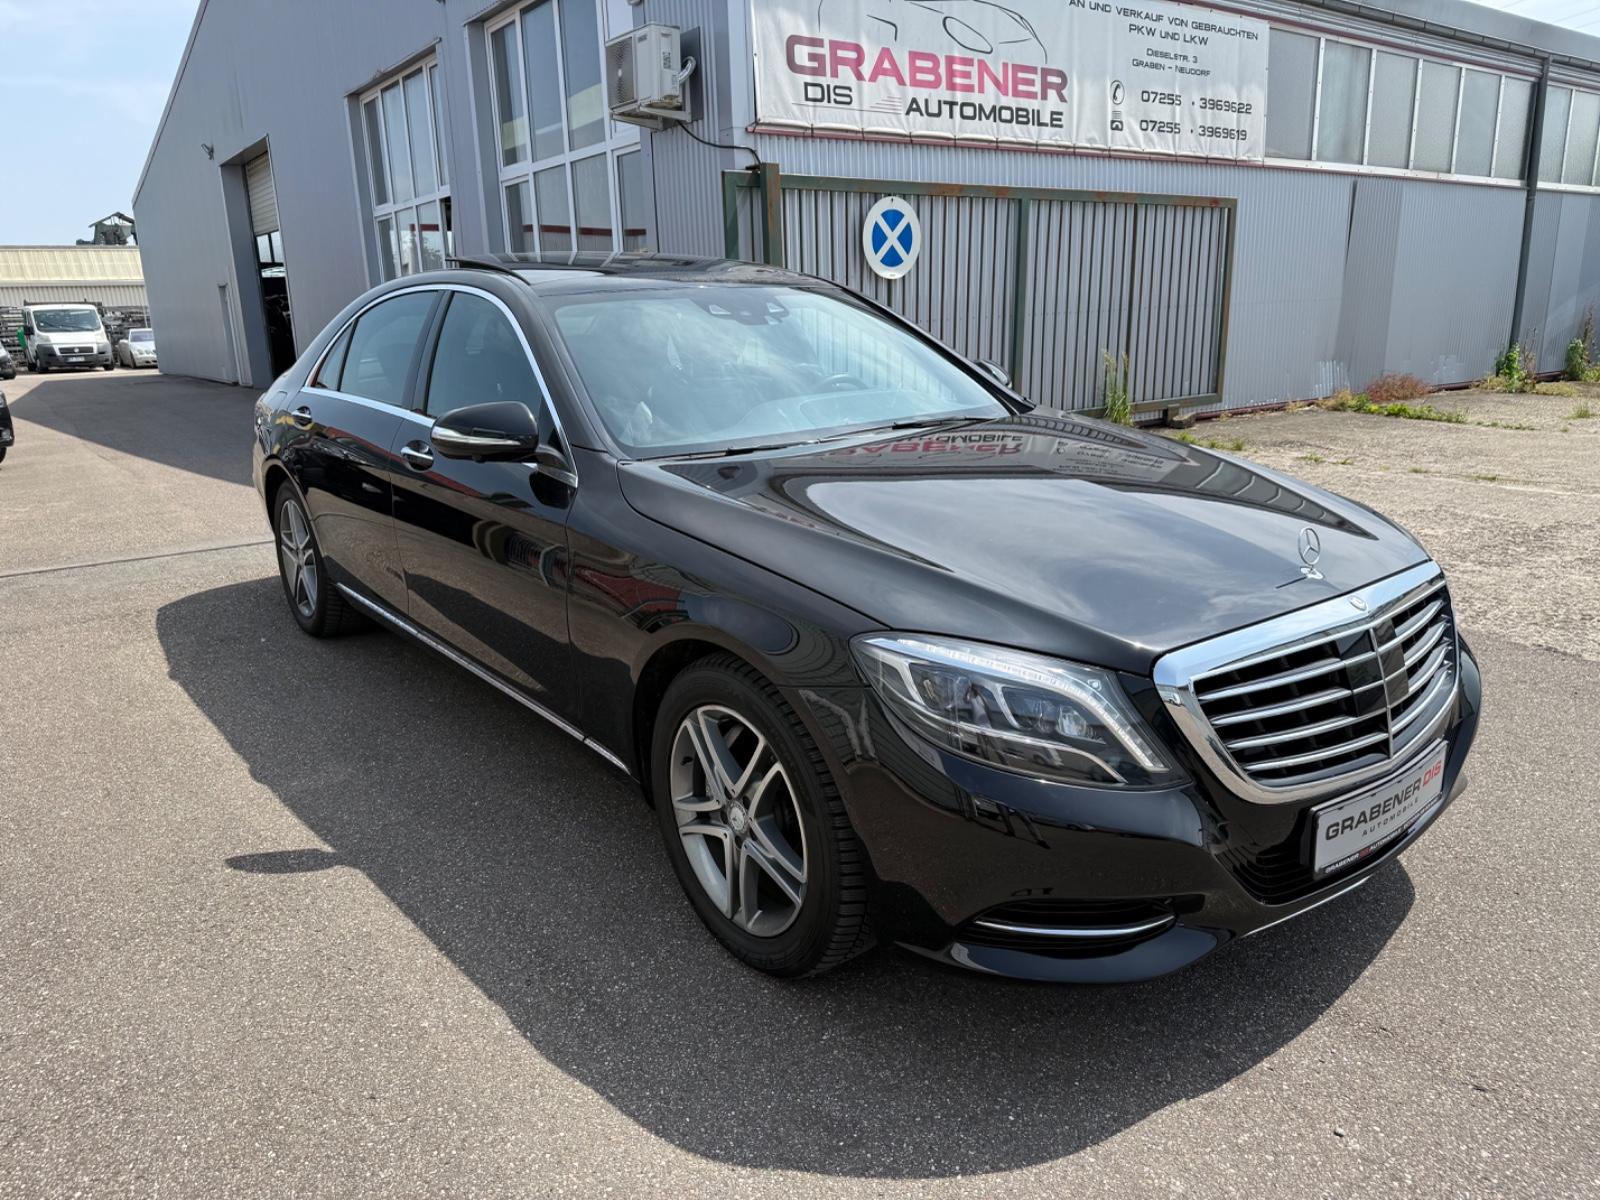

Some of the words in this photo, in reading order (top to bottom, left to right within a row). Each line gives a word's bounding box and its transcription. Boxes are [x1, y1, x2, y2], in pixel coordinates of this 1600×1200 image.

[1068, 0, 1085, 9] AN
[1089, 1, 1112, 13] UND
[1115, 5, 1164, 23] VERKAUF
[1167, 16, 1188, 28] VON
[1191, 21, 1259, 41] GEBRAUCHTEN
[1128, 23, 1156, 37] PKW
[1159, 31, 1180, 42] UND
[1183, 35, 1209, 46] LKW
[785, 34, 1068, 103] GRABENER
[1132, 58, 1165, 71] GRABEN
[1174, 65, 1211, 77] NEUDORF
[1192, 55, 1198, 64] 3
[803, 81, 853, 106] DIS
[905, 96, 1064, 129] AUTOMOBILE
[1141, 90, 1182, 106] 07255
[1199, 97, 1252, 115] 3969622
[1139, 119, 1181, 134] 07255
[1198, 125, 1247, 141] 3969619
[1325, 778, 1421, 841] GRABENER
[1422, 760, 1441, 787] DIS
[1362, 797, 1418, 837] AUTOMOBILE
